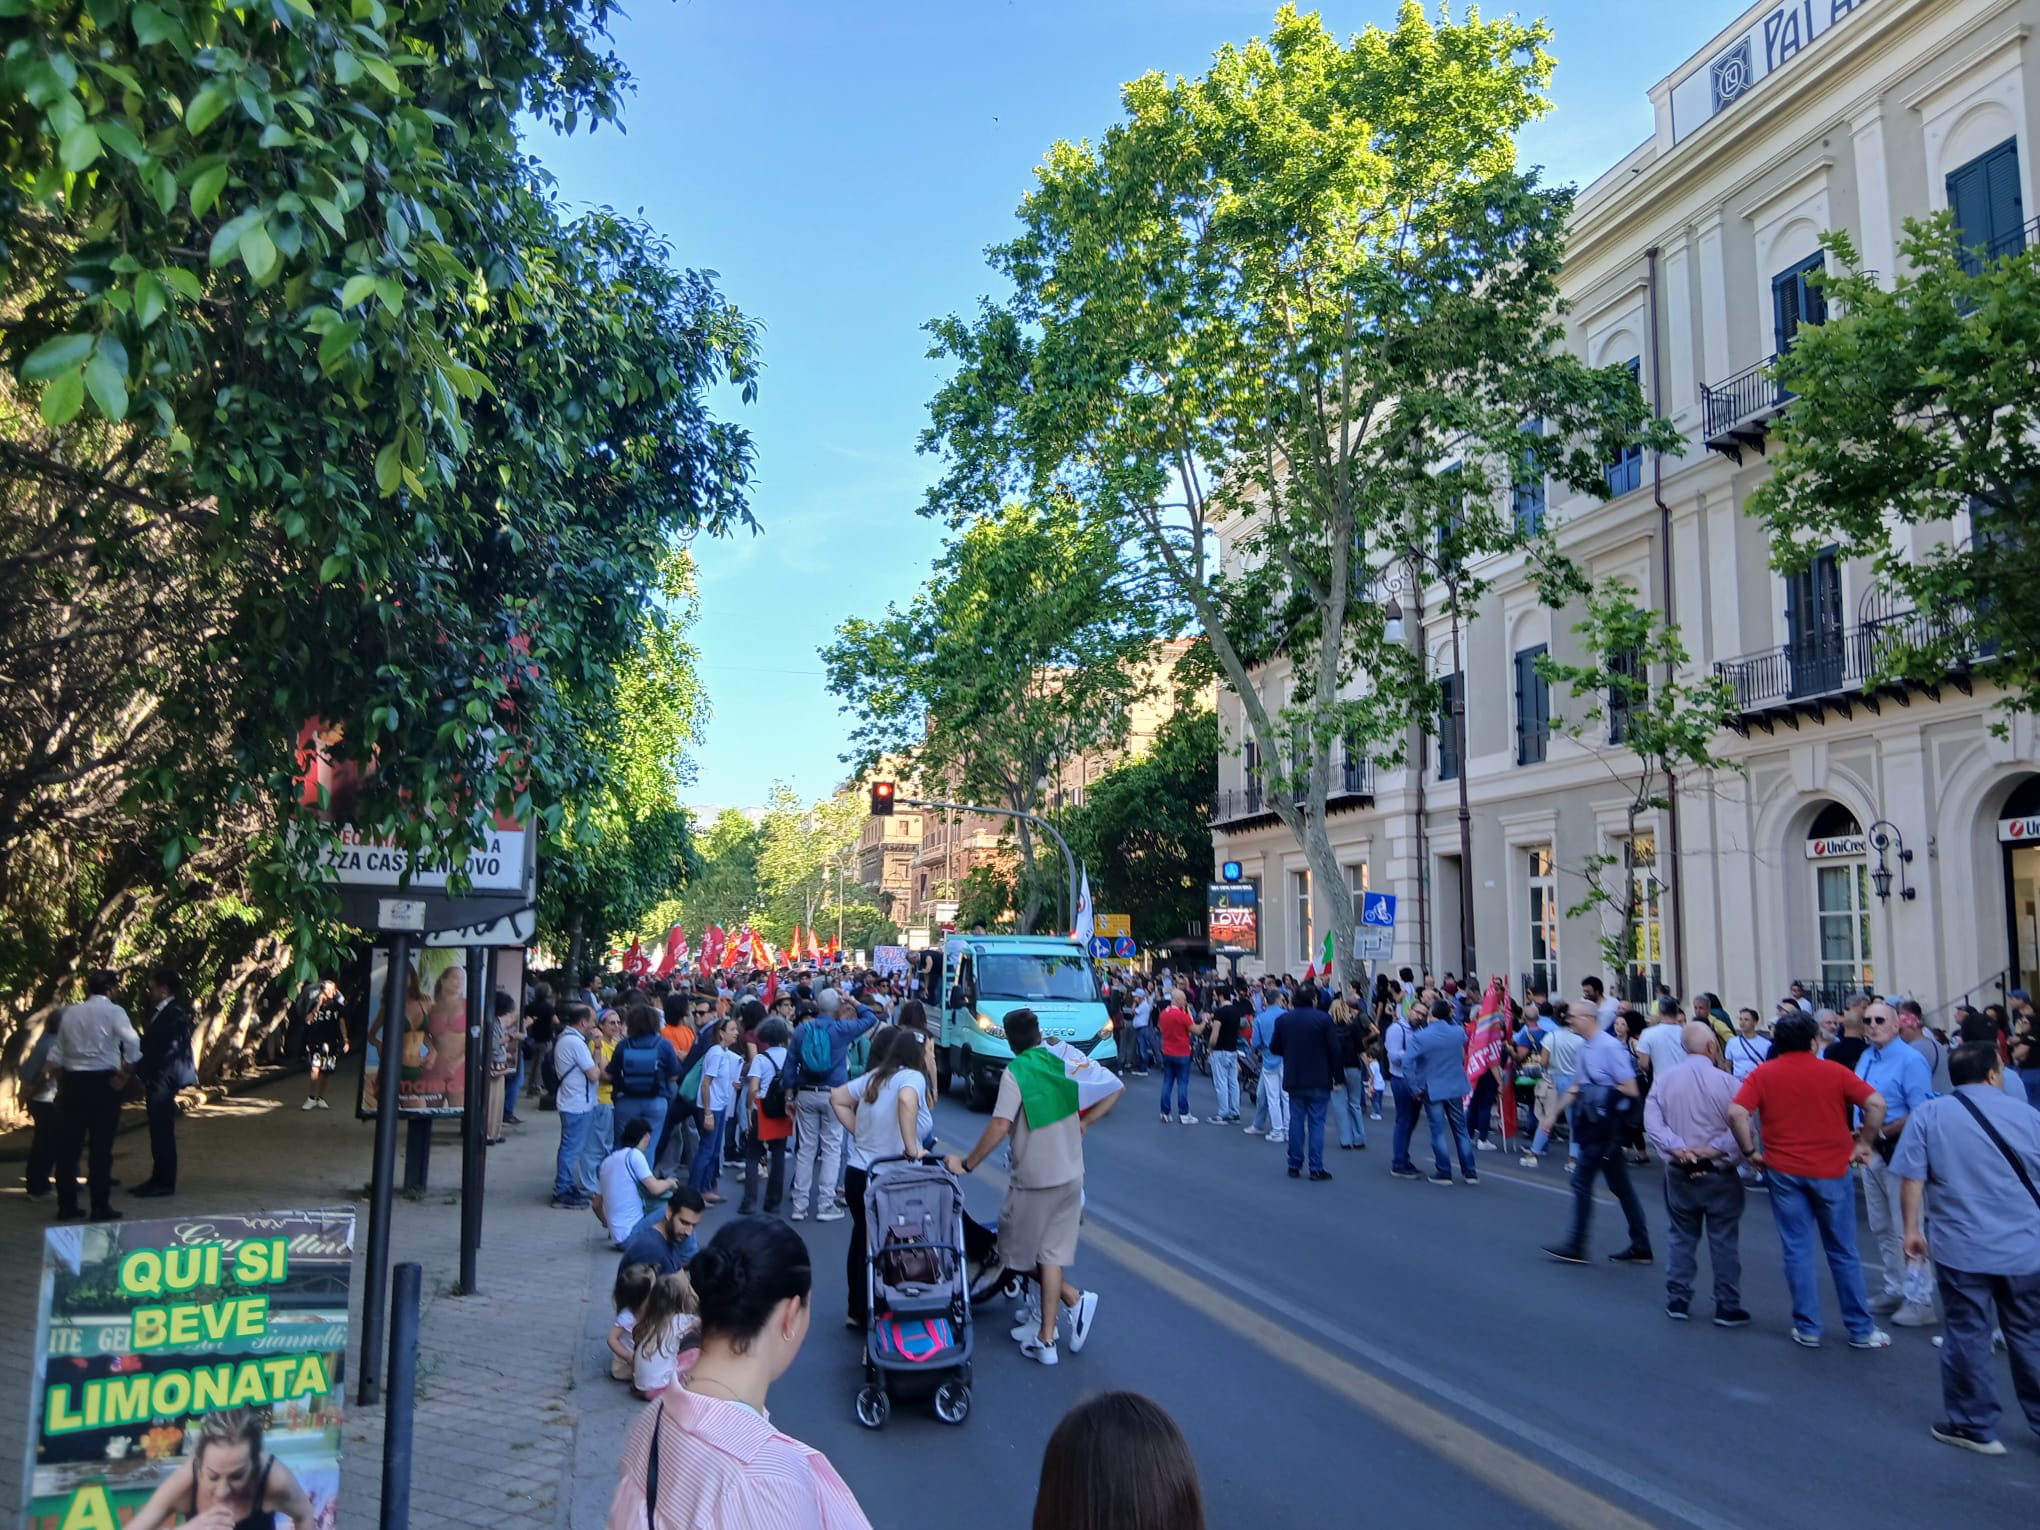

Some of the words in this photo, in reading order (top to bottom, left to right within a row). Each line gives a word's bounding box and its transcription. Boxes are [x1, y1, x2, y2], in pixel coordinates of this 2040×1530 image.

[122, 1246, 220, 1294] QUI
[236, 1240, 286, 1282] SI
[134, 1298, 266, 1349] BEVE
[48, 1352, 328, 1431] LIMONATA
